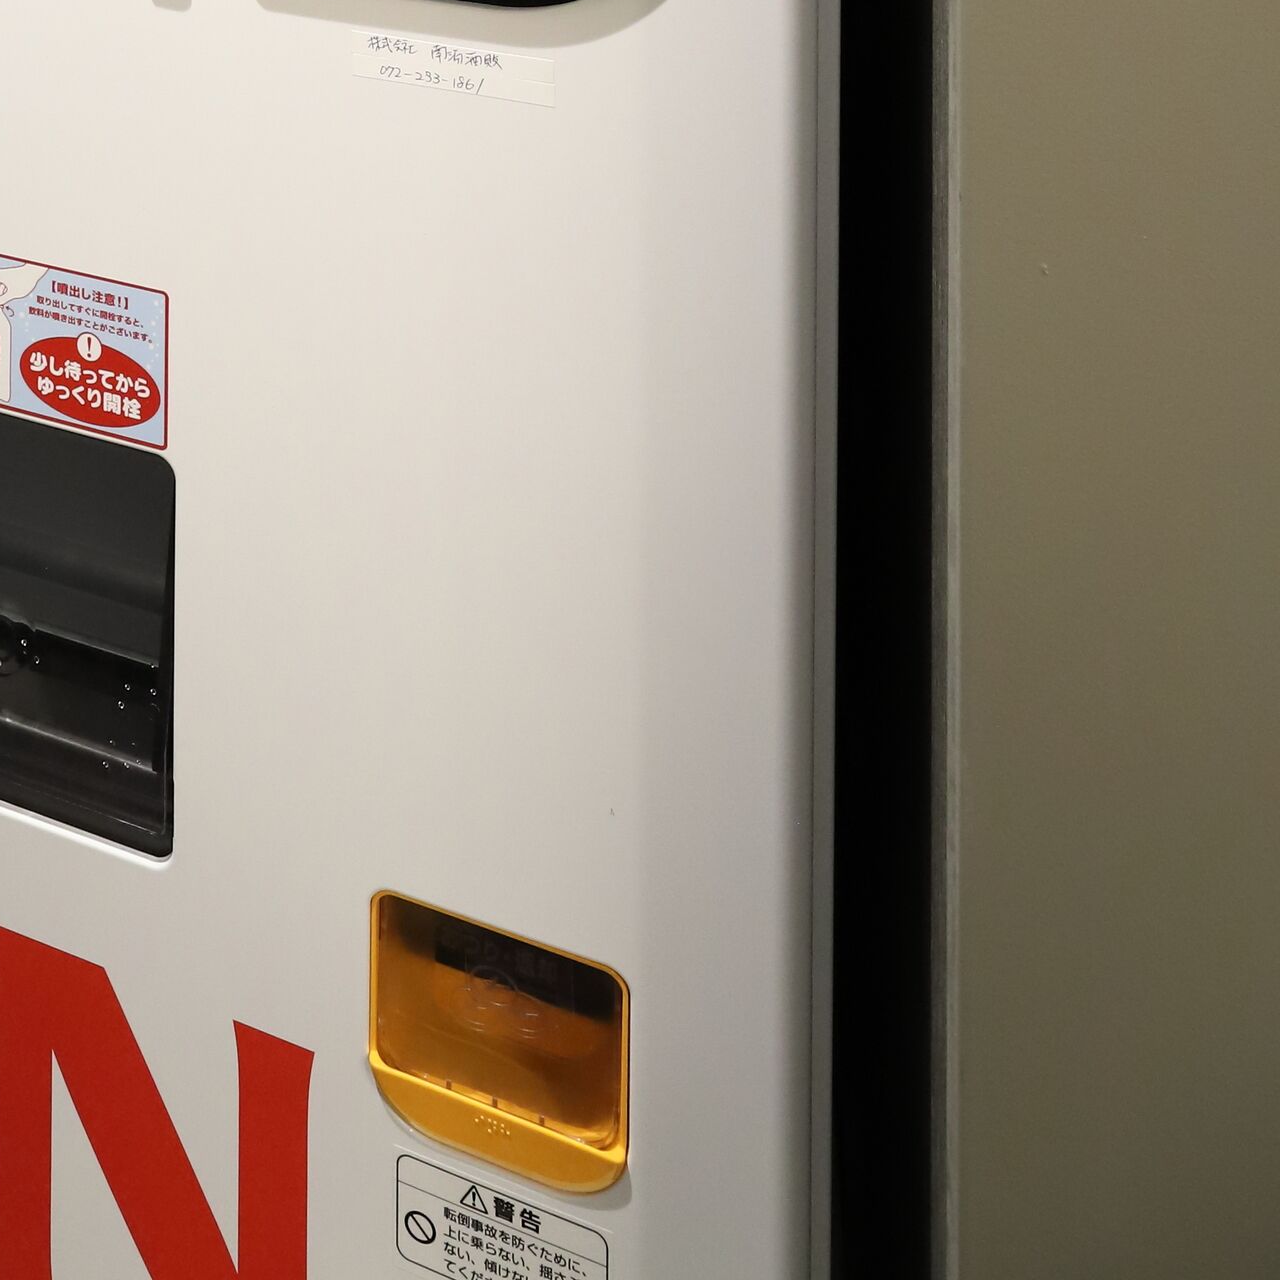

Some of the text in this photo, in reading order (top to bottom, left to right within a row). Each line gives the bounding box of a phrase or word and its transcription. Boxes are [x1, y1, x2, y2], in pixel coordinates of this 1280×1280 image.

[28, 306, 153, 344] 飲料が噴き出すことがございます。
[36, 295, 144, 329] 取り出してすぐに開栓すると、
[29, 351, 151, 398] 少し待ってから
[37, 375, 142, 420] ゆっくり開栓
[493, 1196, 542, 1235] 警告
[443, 1225, 582, 1280] 上に乗らない、揺さ
[443, 1241, 530, 1280] ない、傾けな
[444, 1206, 587, 1277] 転倒事故を防ぐために、
